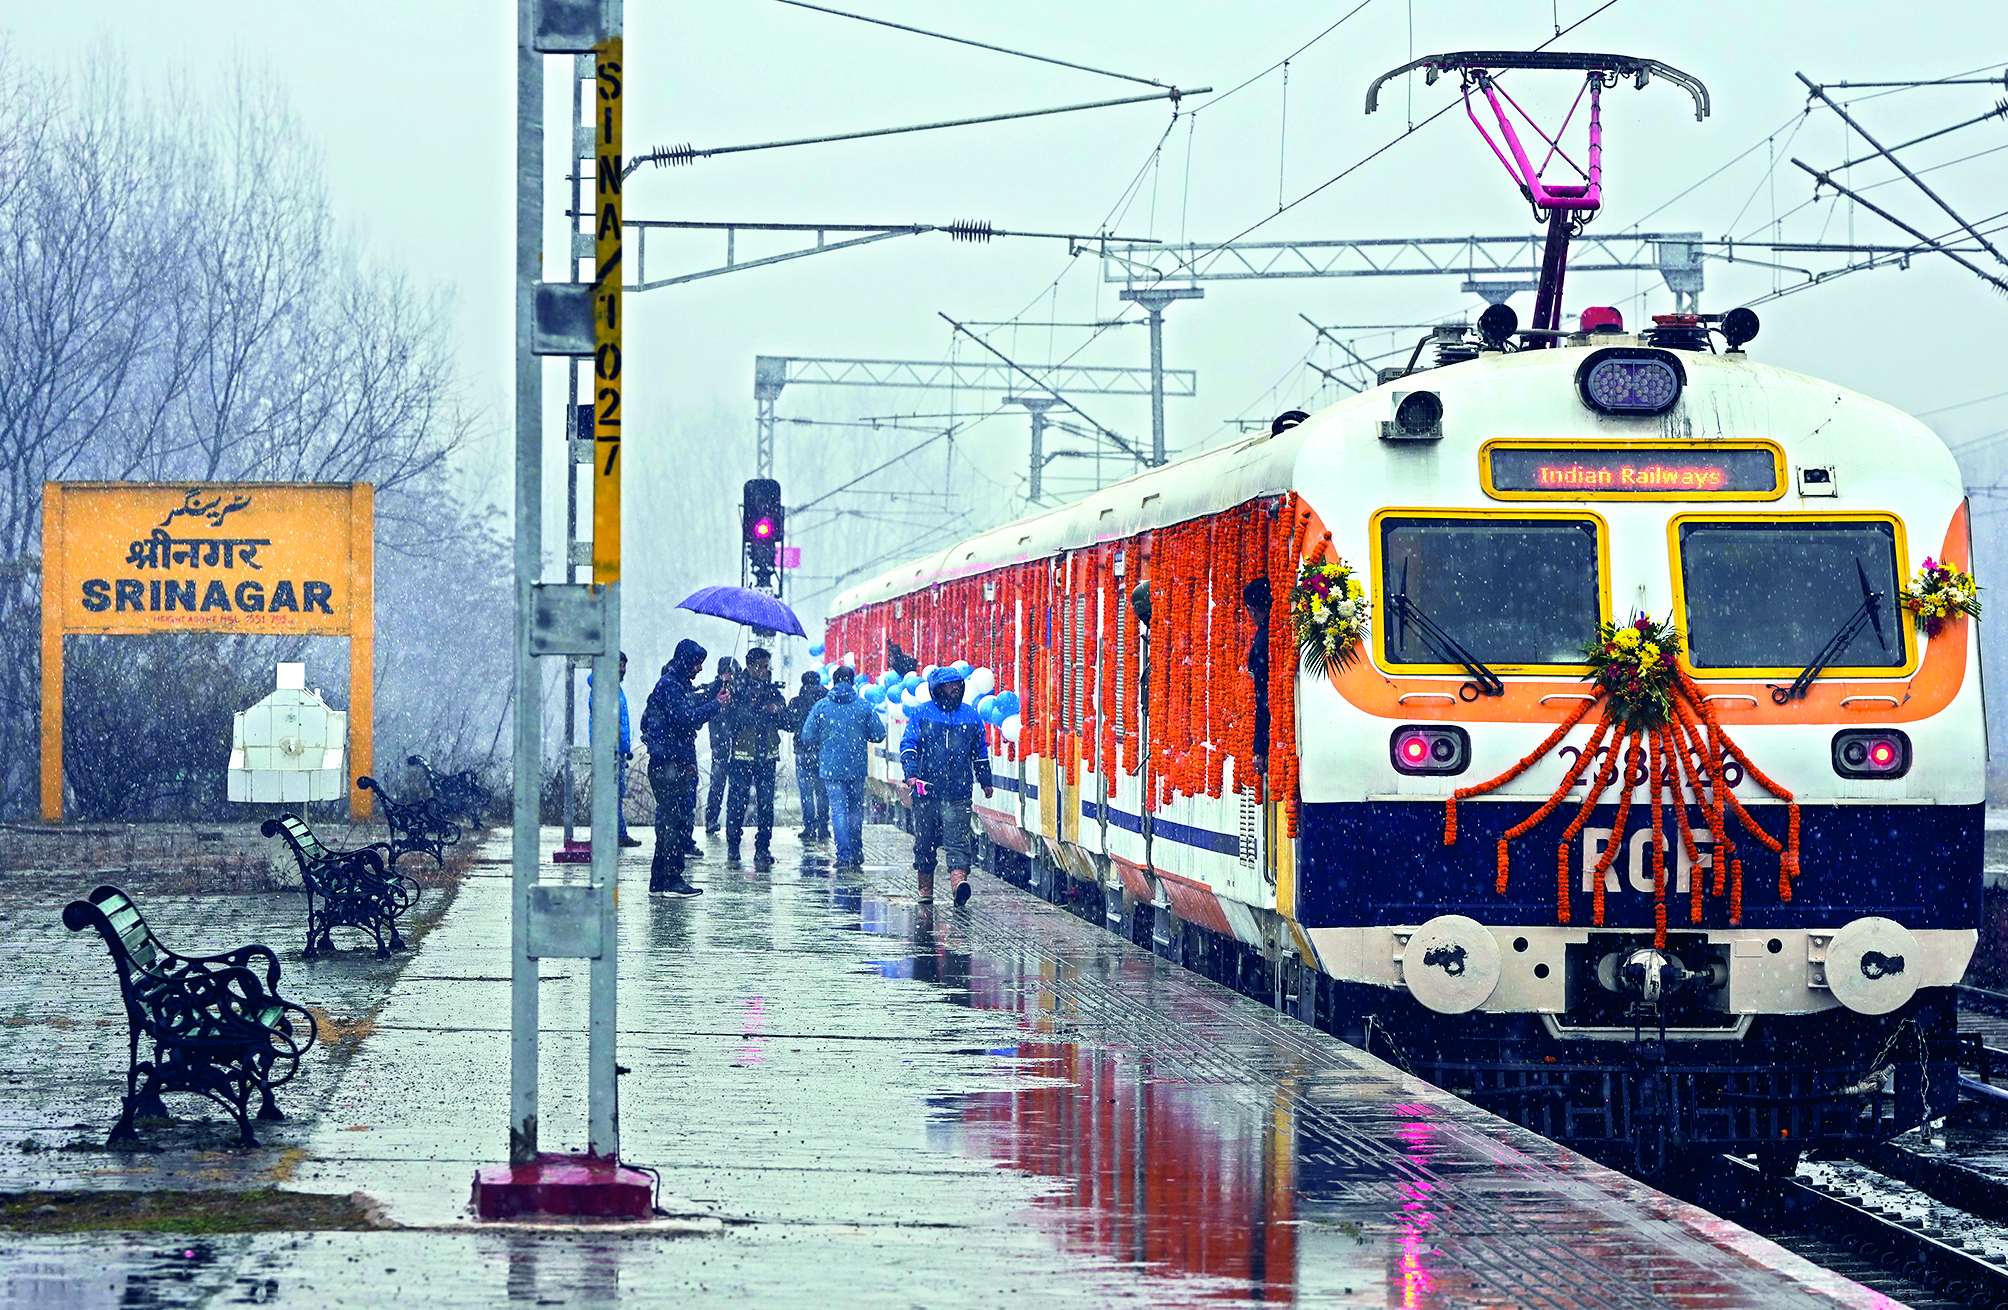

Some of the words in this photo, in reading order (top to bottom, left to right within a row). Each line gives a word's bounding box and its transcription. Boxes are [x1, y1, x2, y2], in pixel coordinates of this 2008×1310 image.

[1541, 466, 1611, 484] Indian
[1621, 466, 1721, 488] Railways
[125, 528, 272, 570] श्रीनगर
[81, 578, 334, 615] SRINAGAR
[1582, 827, 1716, 893] RCF
